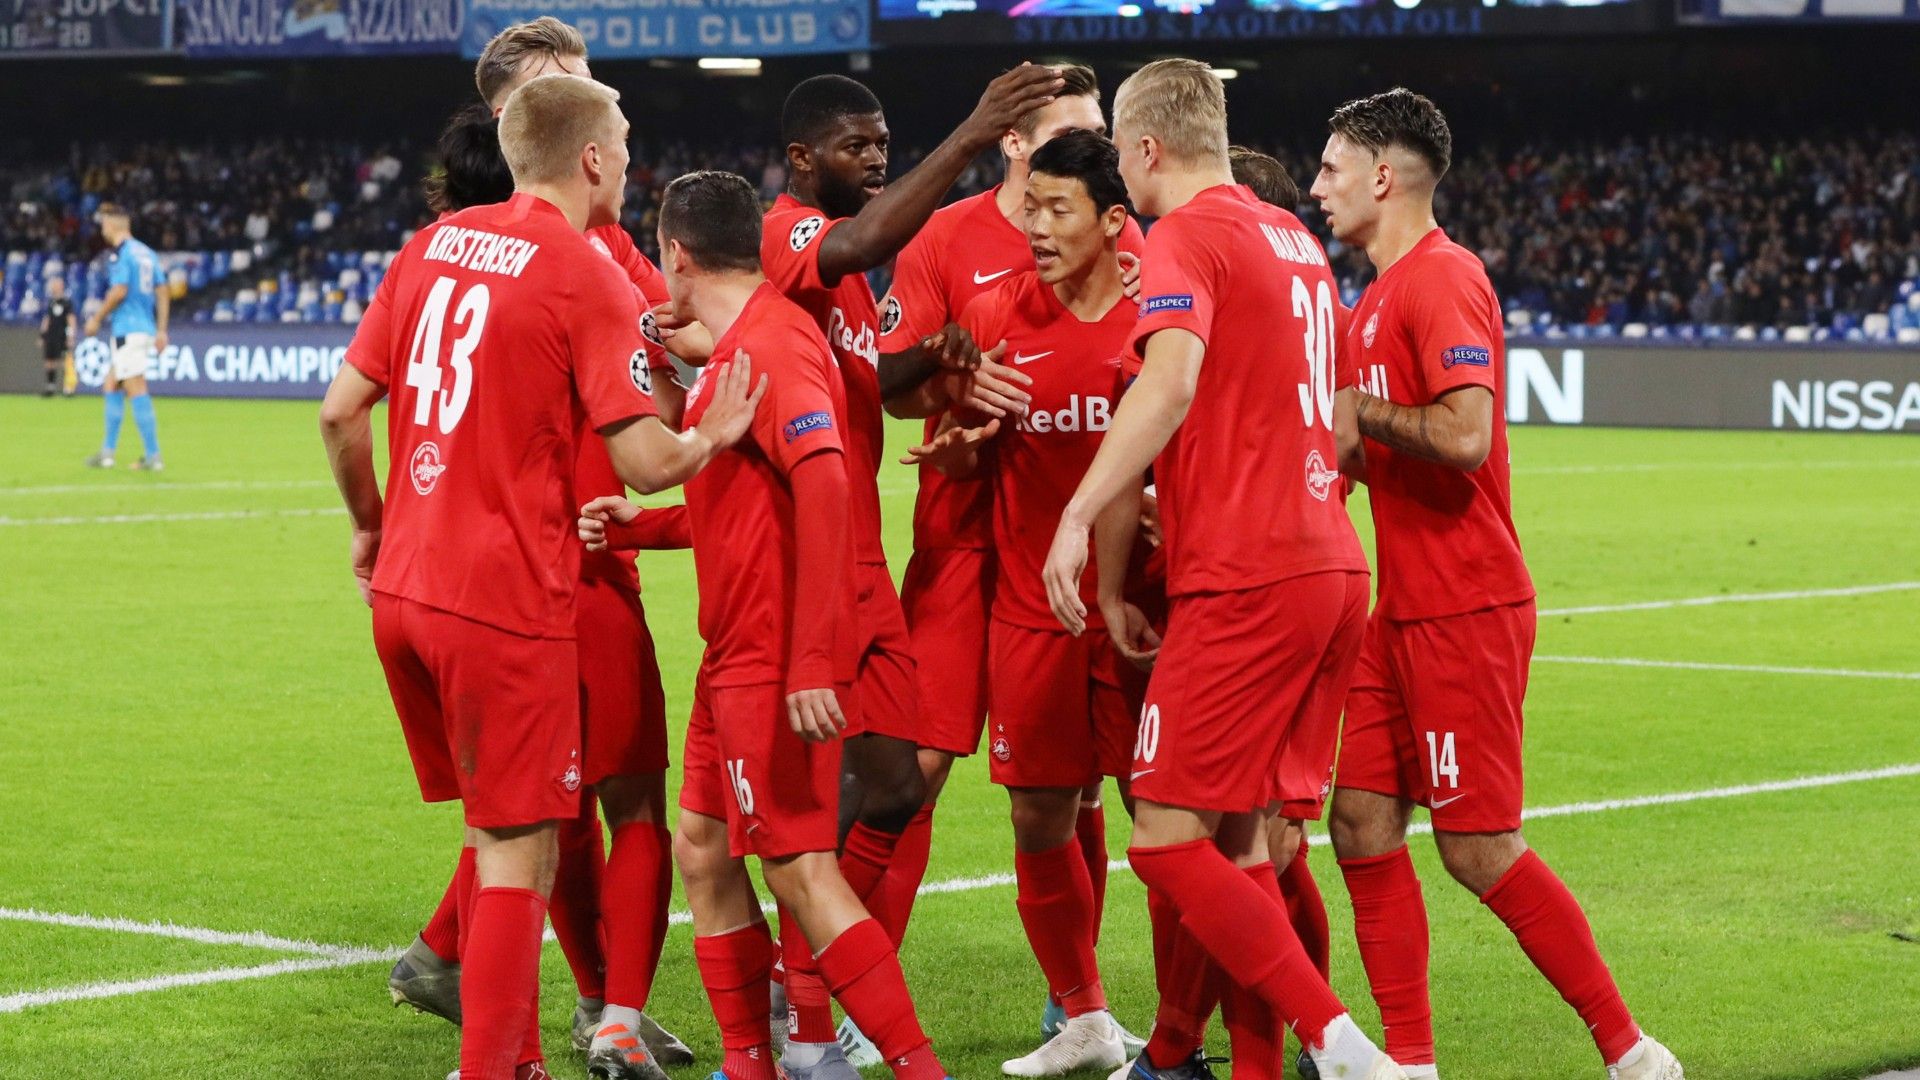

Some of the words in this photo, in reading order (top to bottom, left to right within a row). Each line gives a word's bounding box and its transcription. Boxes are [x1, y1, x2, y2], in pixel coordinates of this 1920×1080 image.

[576, 15, 675, 47] POLI
[699, 13, 817, 46] CLUB
[1014, 17, 1148, 42] STADIO
[423, 225, 540, 278] KRISTENSEN
[1149, 298, 1191, 309] RESPECT
[145, 344, 201, 381] EFA
[406, 275, 491, 435] 43
[1291, 275, 1336, 432] 30
[1454, 350, 1489, 362] RESPECT
[795, 415, 831, 431] RESPECT
[1771, 379, 1920, 431] NISSA
[1426, 731, 1460, 789] 14
[727, 758, 754, 816] 16
